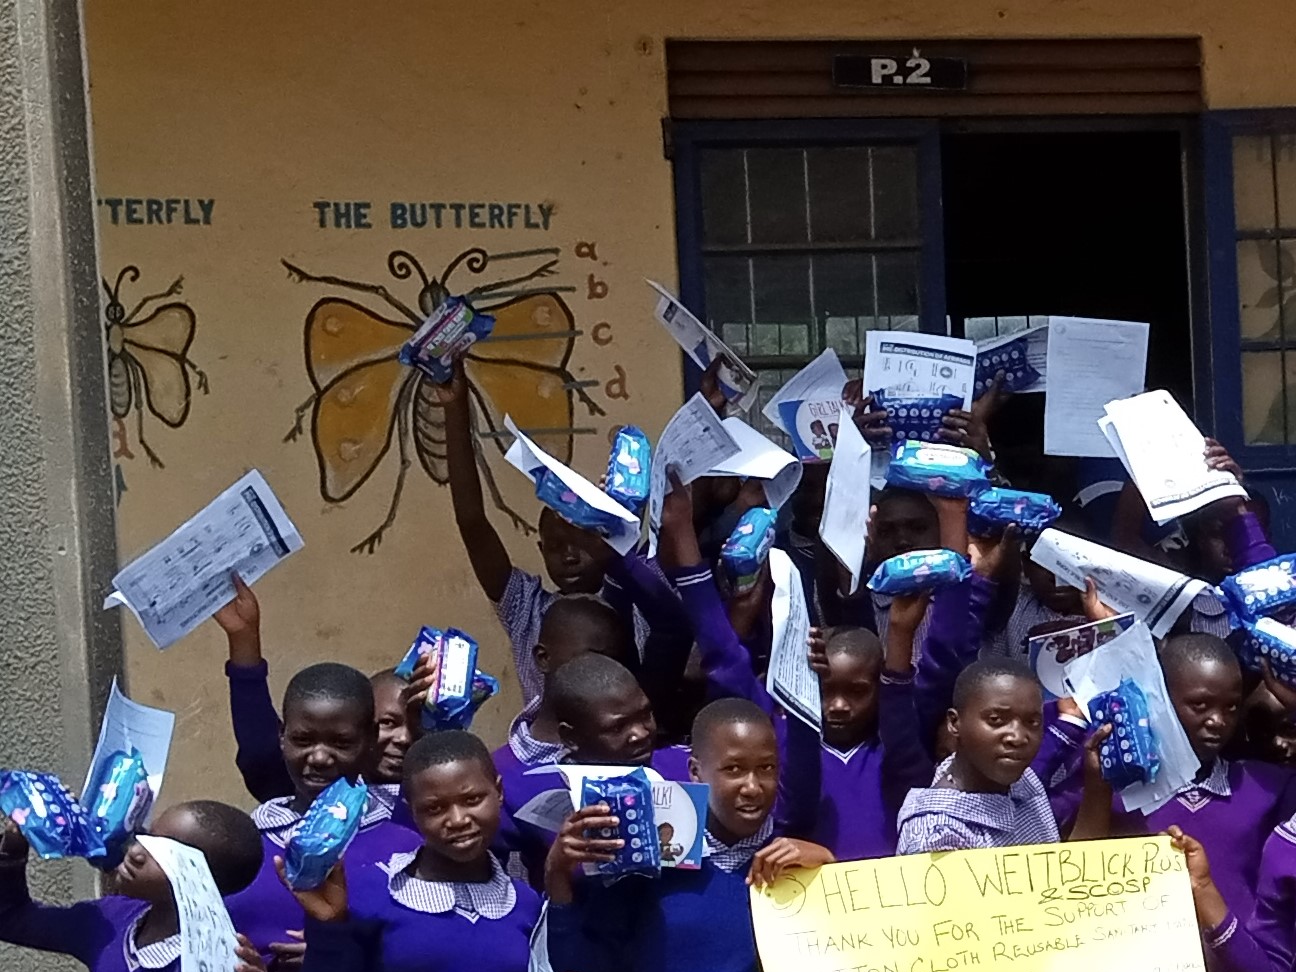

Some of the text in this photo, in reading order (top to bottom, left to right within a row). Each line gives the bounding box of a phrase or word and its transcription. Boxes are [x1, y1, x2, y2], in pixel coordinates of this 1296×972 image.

[871, 58, 931, 84] P.2
[97, 198, 215, 225] TERFLY
[312, 201, 554, 230] THE BUTTERFLY
[587, 273, 609, 300] b
[591, 322, 613, 346] c
[605, 364, 630, 400] d
[821, 842, 1182, 915] HELLO WEITBLICK PLUS
[786, 931, 874, 956] THANK
[882, 925, 919, 949] YOU
[933, 919, 980, 947] FOR
[991, 914, 1034, 936] THE
[1142, 894, 1170, 911] OF
[993, 935, 1086, 961] REUSABLE
